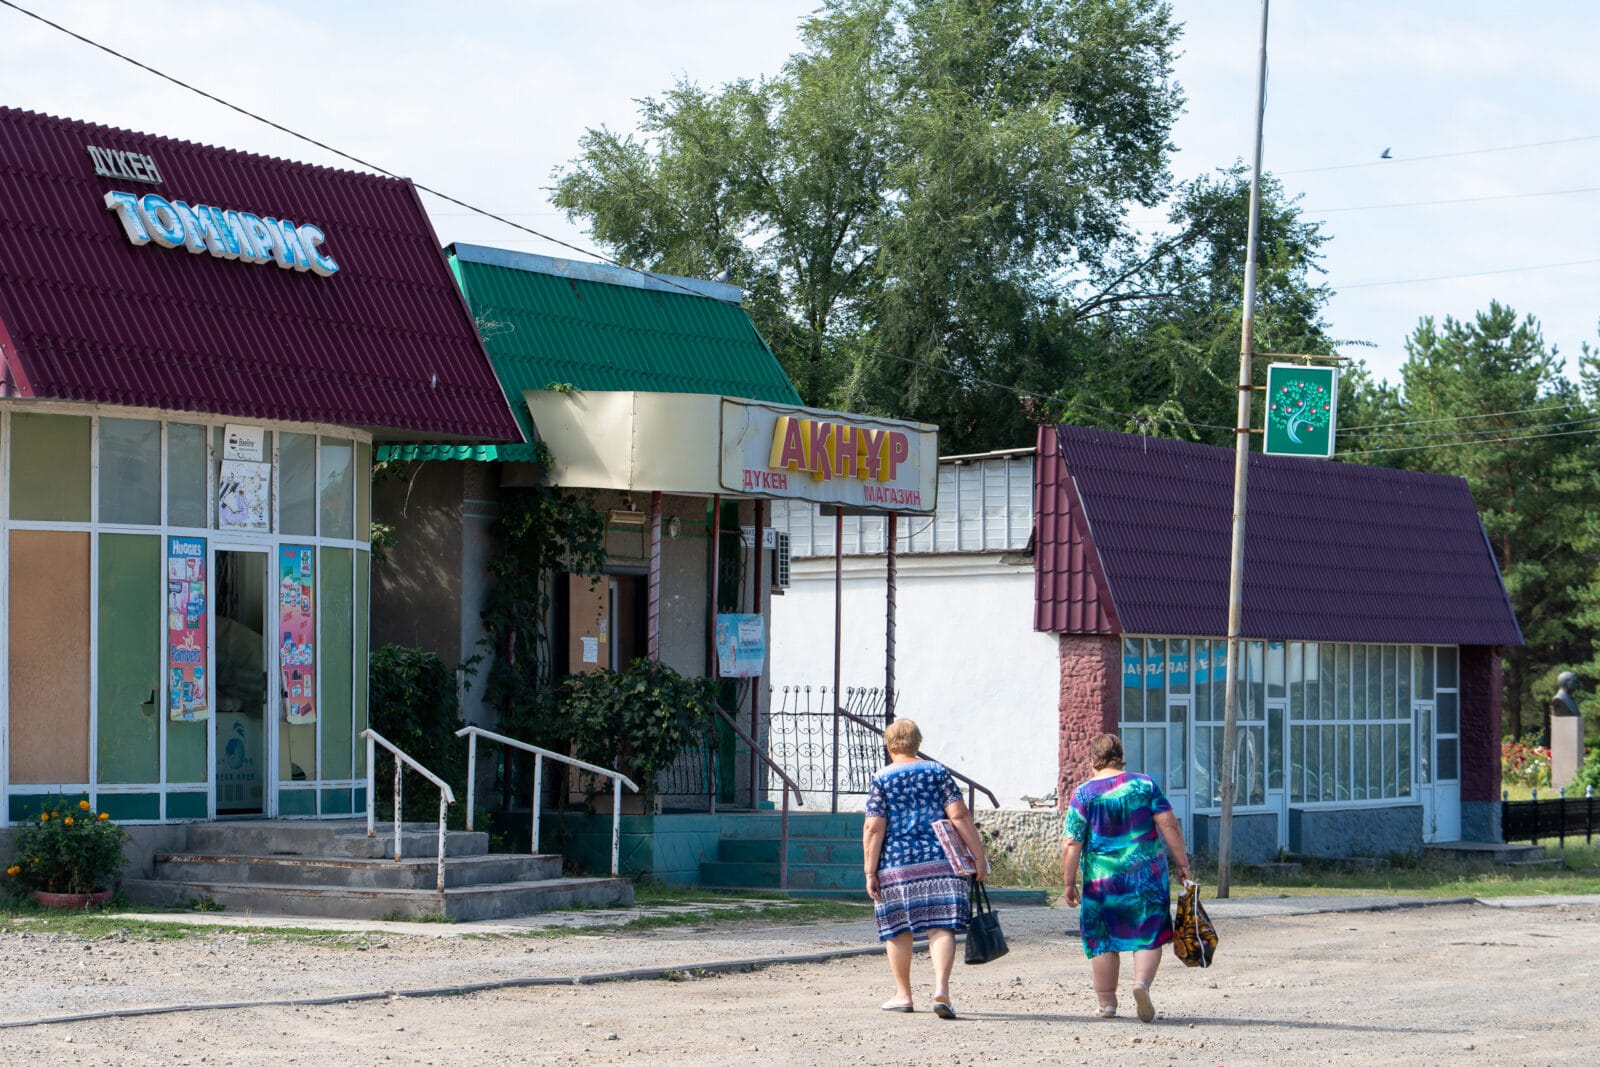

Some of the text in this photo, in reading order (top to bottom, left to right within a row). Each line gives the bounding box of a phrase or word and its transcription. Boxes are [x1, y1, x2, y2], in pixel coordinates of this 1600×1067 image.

[104, 190, 340, 278] ТОМИРИС
[864, 485, 921, 506] МАГАЗИН
[172, 540, 202, 556] HUGGIES
